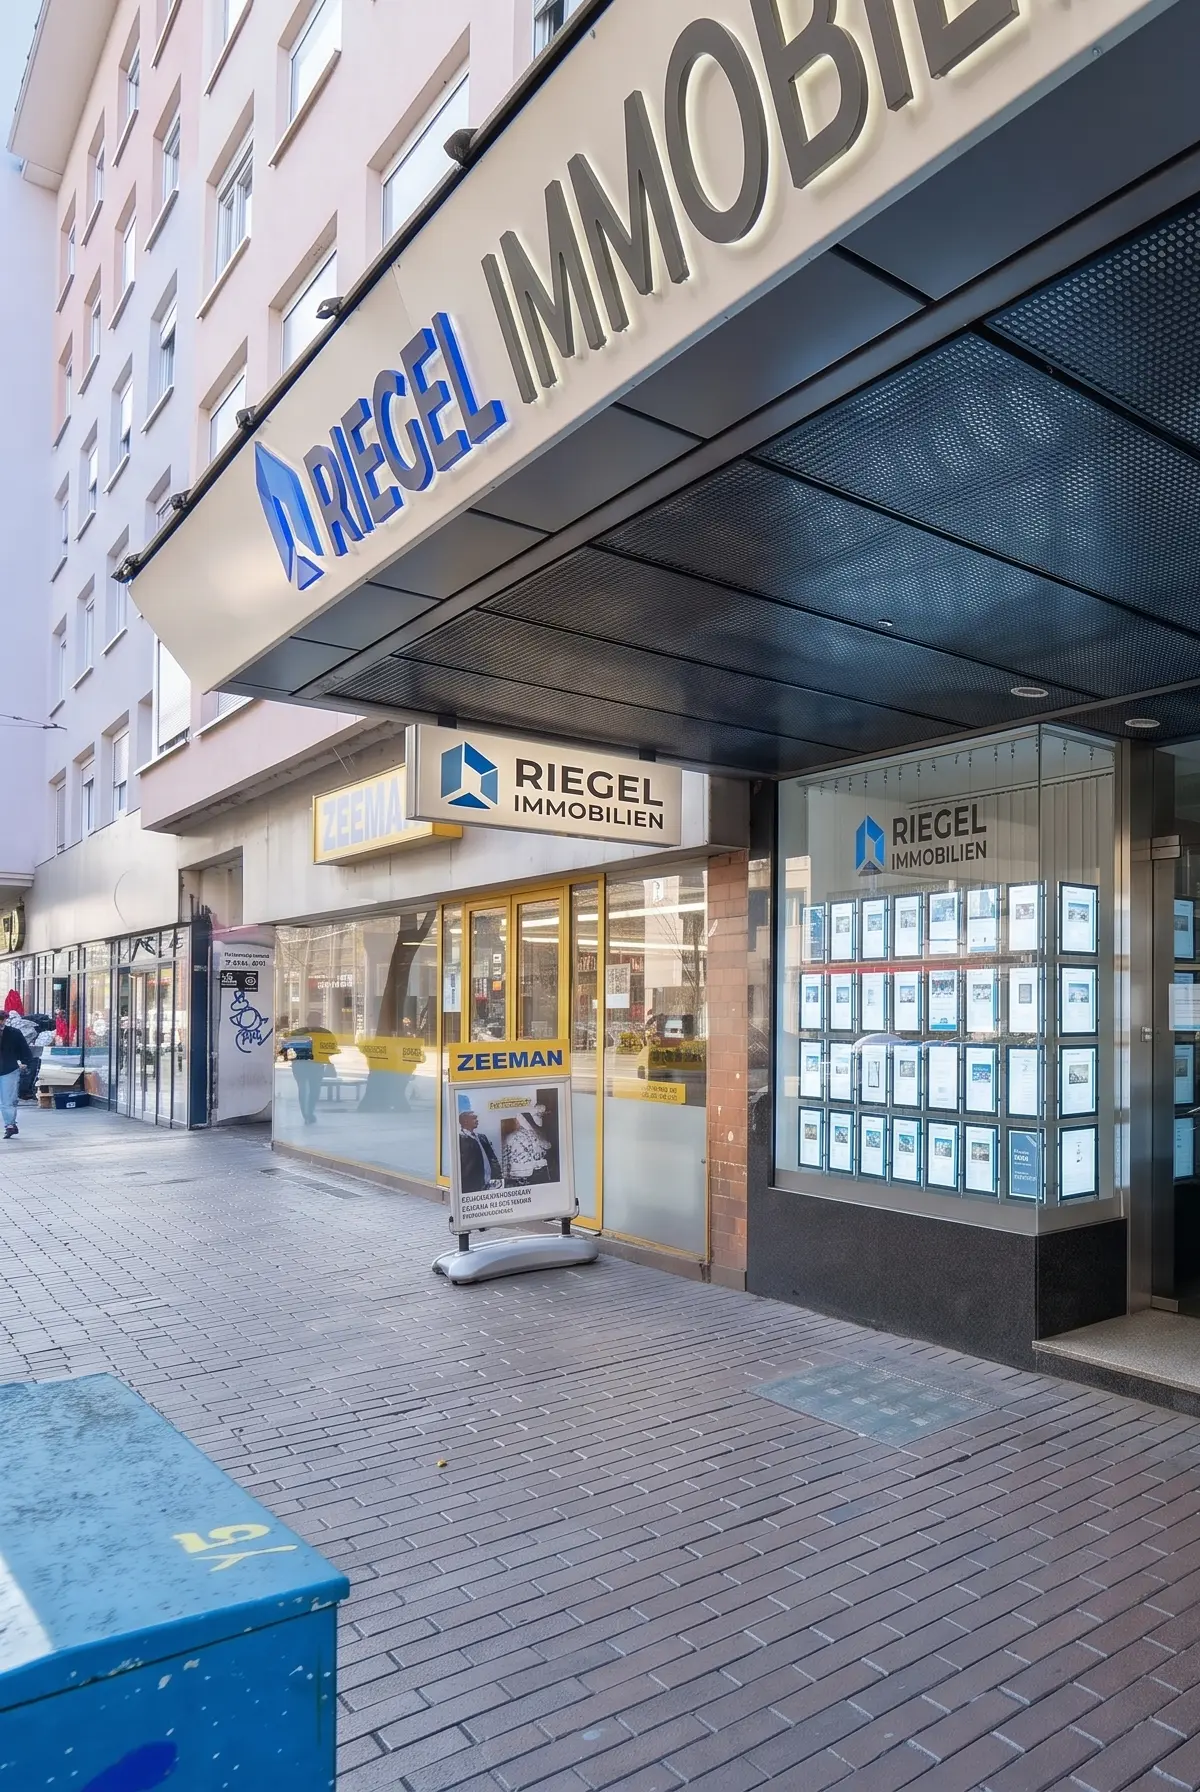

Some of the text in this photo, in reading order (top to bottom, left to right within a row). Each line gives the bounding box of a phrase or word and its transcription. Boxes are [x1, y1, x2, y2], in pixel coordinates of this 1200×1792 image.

[303, 0, 1020, 556] RIEGEL IMMOB
[515, 757, 664, 807] RIEGEL
[323, 775, 427, 852] ZEEMA
[514, 795, 664, 830] IMMOBILIEN
[892, 803, 987, 846] RIEGEL
[891, 840, 987, 870] IMMOBILIEN
[457, 1050, 563, 1072] ZEEMAN
